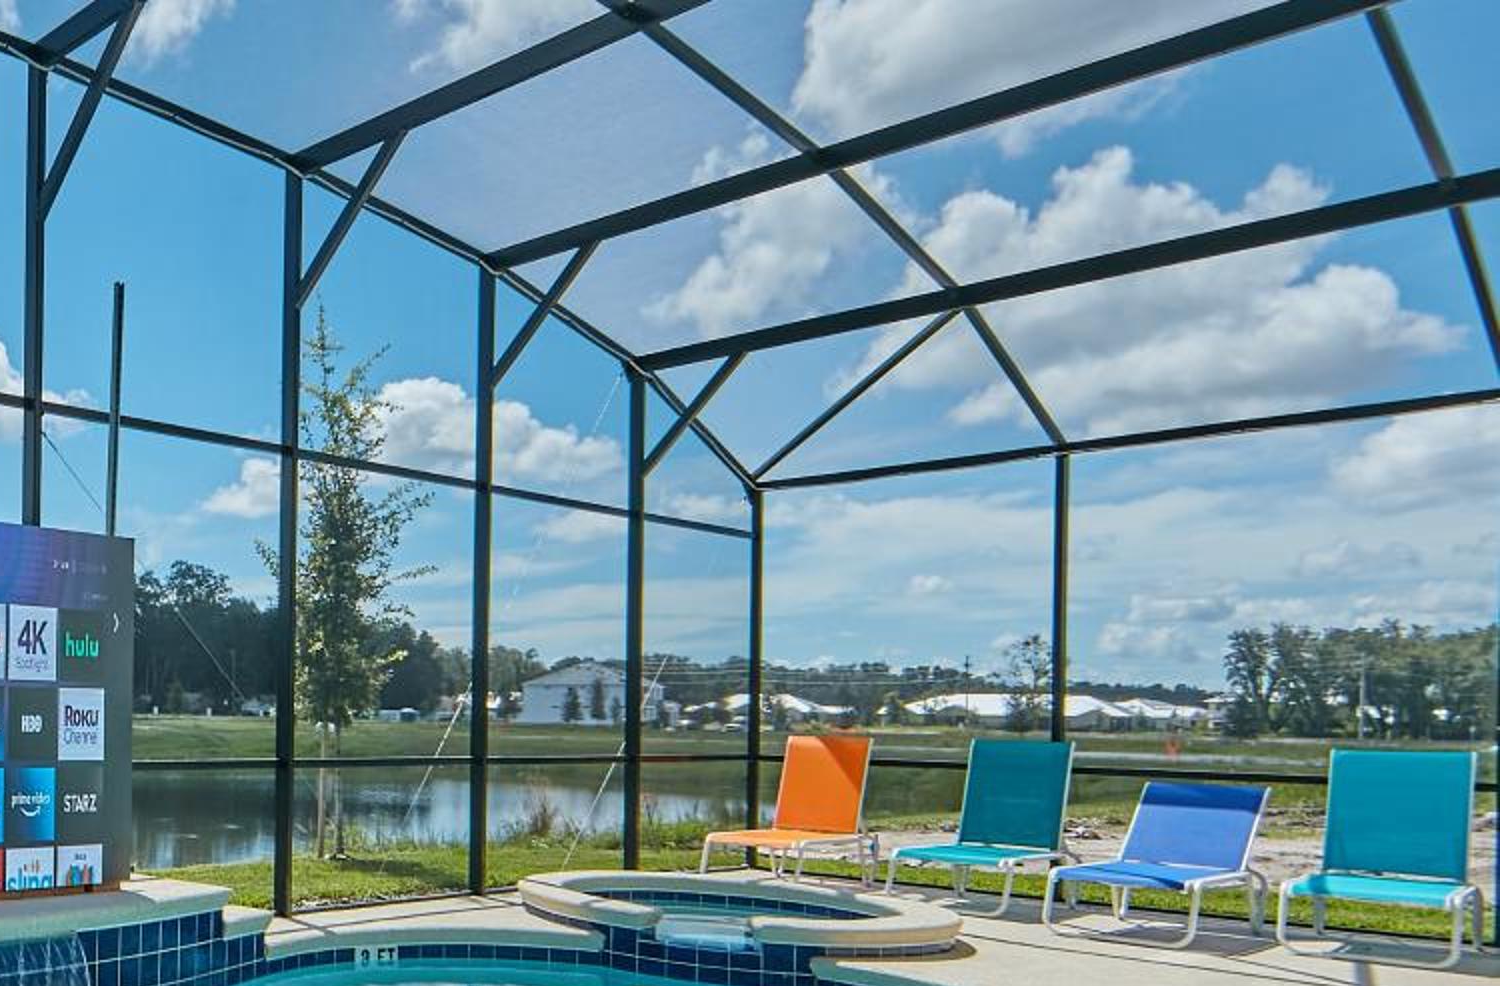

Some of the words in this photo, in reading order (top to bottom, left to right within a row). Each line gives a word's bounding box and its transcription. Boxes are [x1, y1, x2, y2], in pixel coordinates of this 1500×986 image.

[17, 619, 48, 655] 4K
[65, 632, 99, 657] hulu
[21, 715, 43, 733] HBO
[11, 791, 31, 809] prime
[32, 791, 51, 805] video
[63, 794, 98, 814] STARZ
